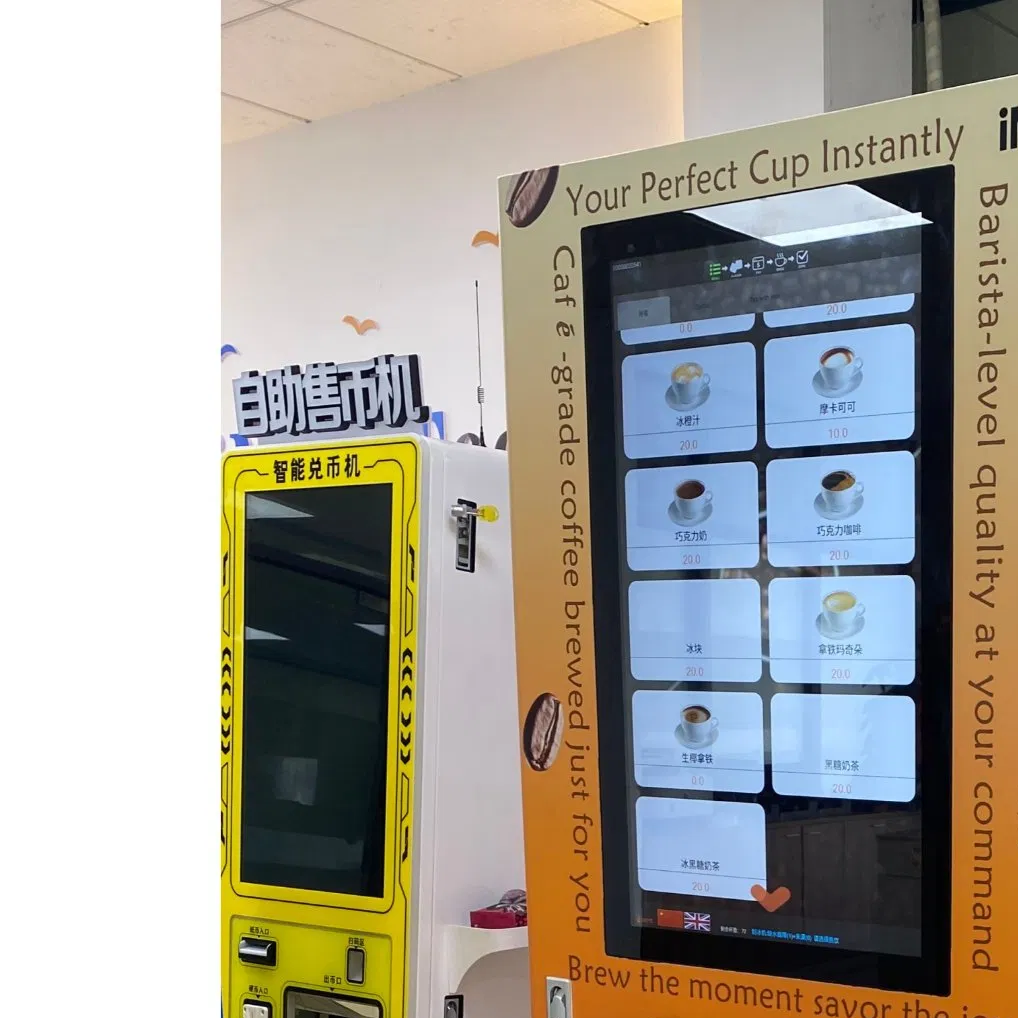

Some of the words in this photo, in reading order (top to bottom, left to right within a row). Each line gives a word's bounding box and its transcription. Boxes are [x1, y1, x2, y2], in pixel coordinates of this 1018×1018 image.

[565, 184, 632, 217] Your
[641, 160, 739, 205] Perfect
[748, 148, 810, 189] Cup
[822, 116, 965, 174] Instantly
[826, 302, 848, 316] 20.0
[976, 182, 1009, 447] Barista-level
[679, 322, 694, 335] 0.0
[233, 355, 428, 437] 自助售币机
[819, 401, 857, 415] 摩卡可可
[675, 415, 701, 428] 冰橙汁
[828, 427, 849, 440] 10.0
[679, 439, 699, 451] 20.0
[273, 454, 361, 484] 智能兑币机
[560, 479, 585, 587] coffee
[674, 530, 708, 543] 巧克力奶
[816, 523, 862, 537] 巧克力咖啡
[968, 463, 1005, 609] quality
[682, 553, 701, 565] 20.0
[829, 549, 850, 561] 20.0
[685, 643, 703, 655] 冰块
[818, 643, 864, 656] 拿铁玛奇朵
[974, 623, 1000, 662] at
[564, 600, 591, 731] brewed
[685, 665, 704, 678] 20.0
[831, 667, 851, 680] 20.0
[967, 674, 996, 769] your
[564, 740, 592, 802] just
[691, 775, 705, 787] 0.0
[832, 783, 853, 795] 20.0
[572, 812, 594, 862] for
[971, 781, 1000, 972] command
[691, 881, 710, 893] 20.0
[568, 871, 591, 933] you
[568, 954, 631, 989] Brew
[639, 965, 680, 997] the
[689, 978, 804, 1014] moment
